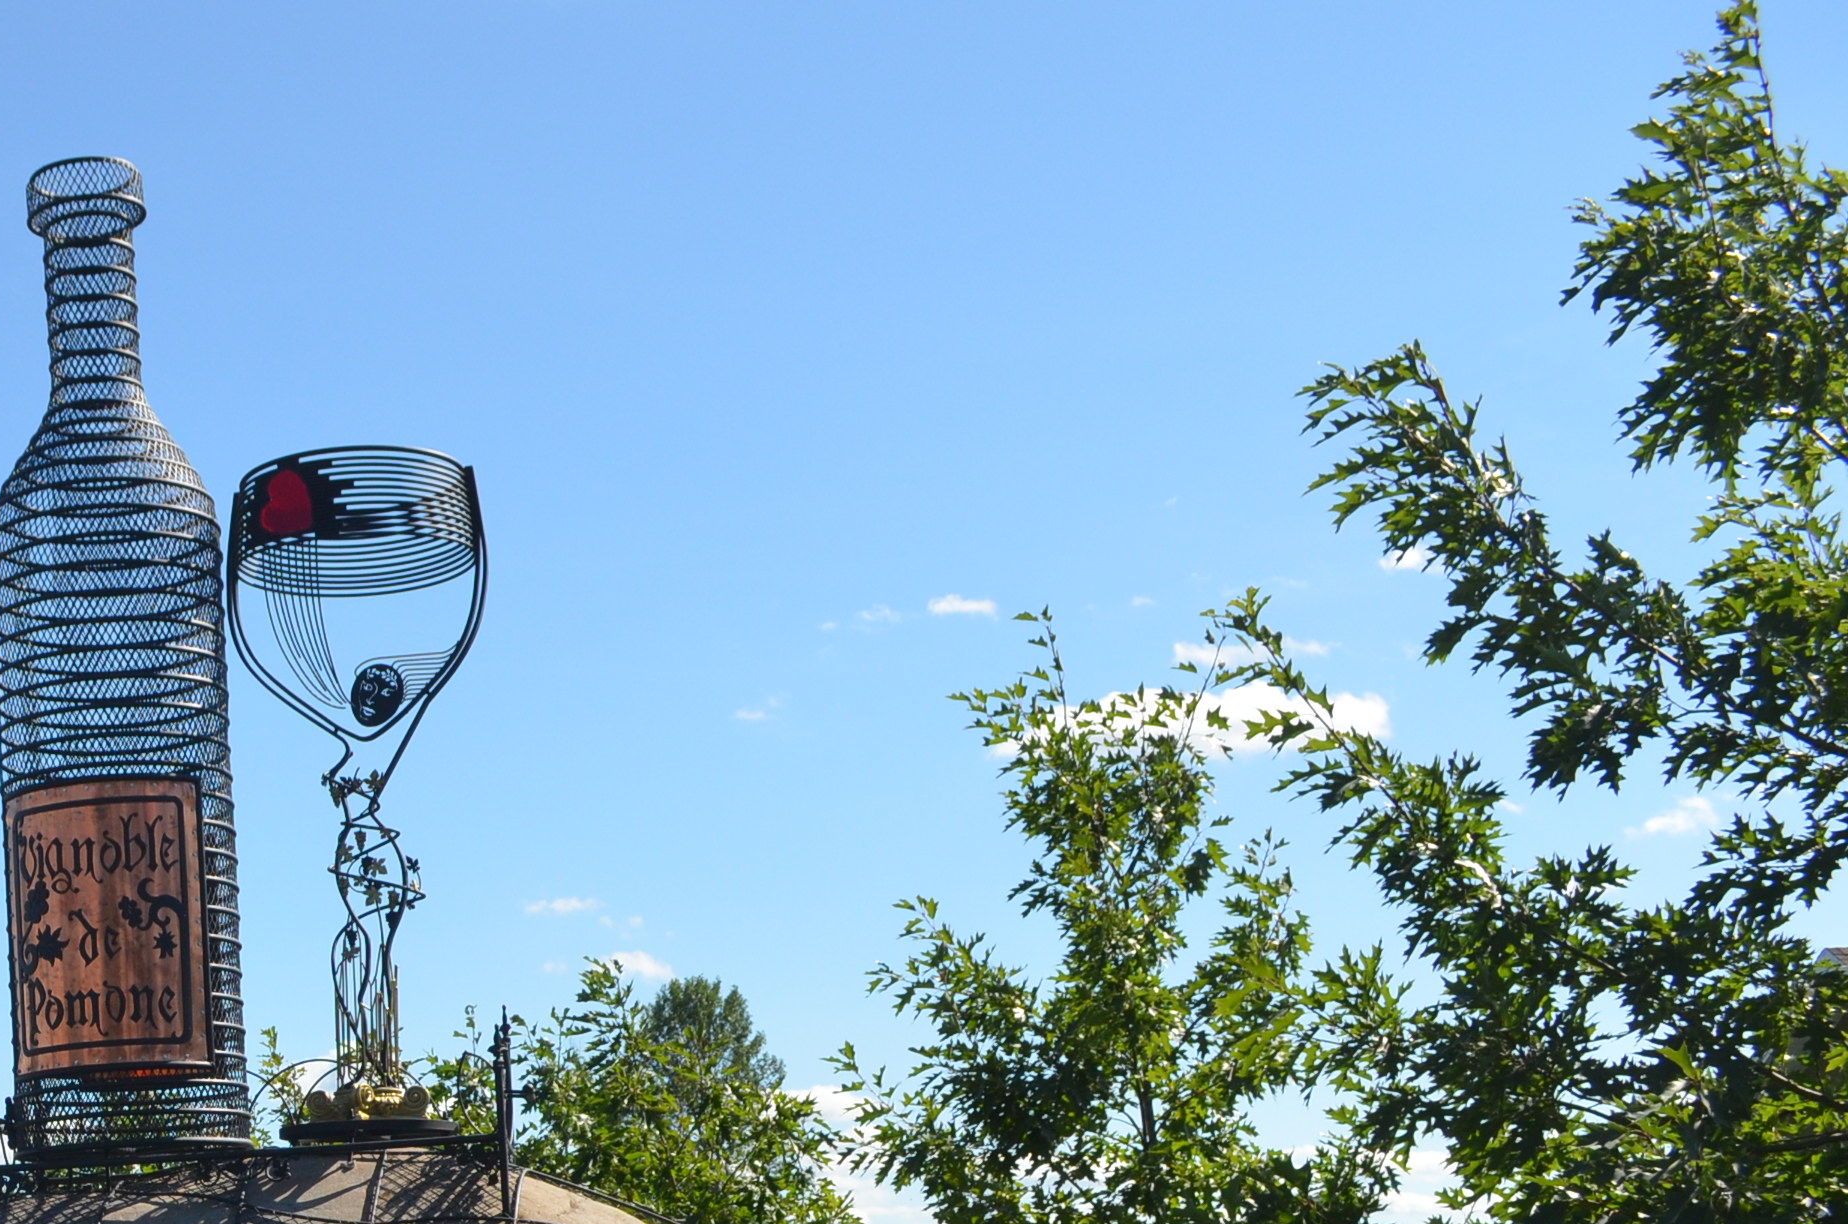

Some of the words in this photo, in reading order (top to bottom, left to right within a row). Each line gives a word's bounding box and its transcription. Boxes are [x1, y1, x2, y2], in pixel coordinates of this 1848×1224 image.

[20, 812, 180, 893] Vignoble
[68, 908, 122, 966] de
[26, 978, 177, 1046] Pomone
